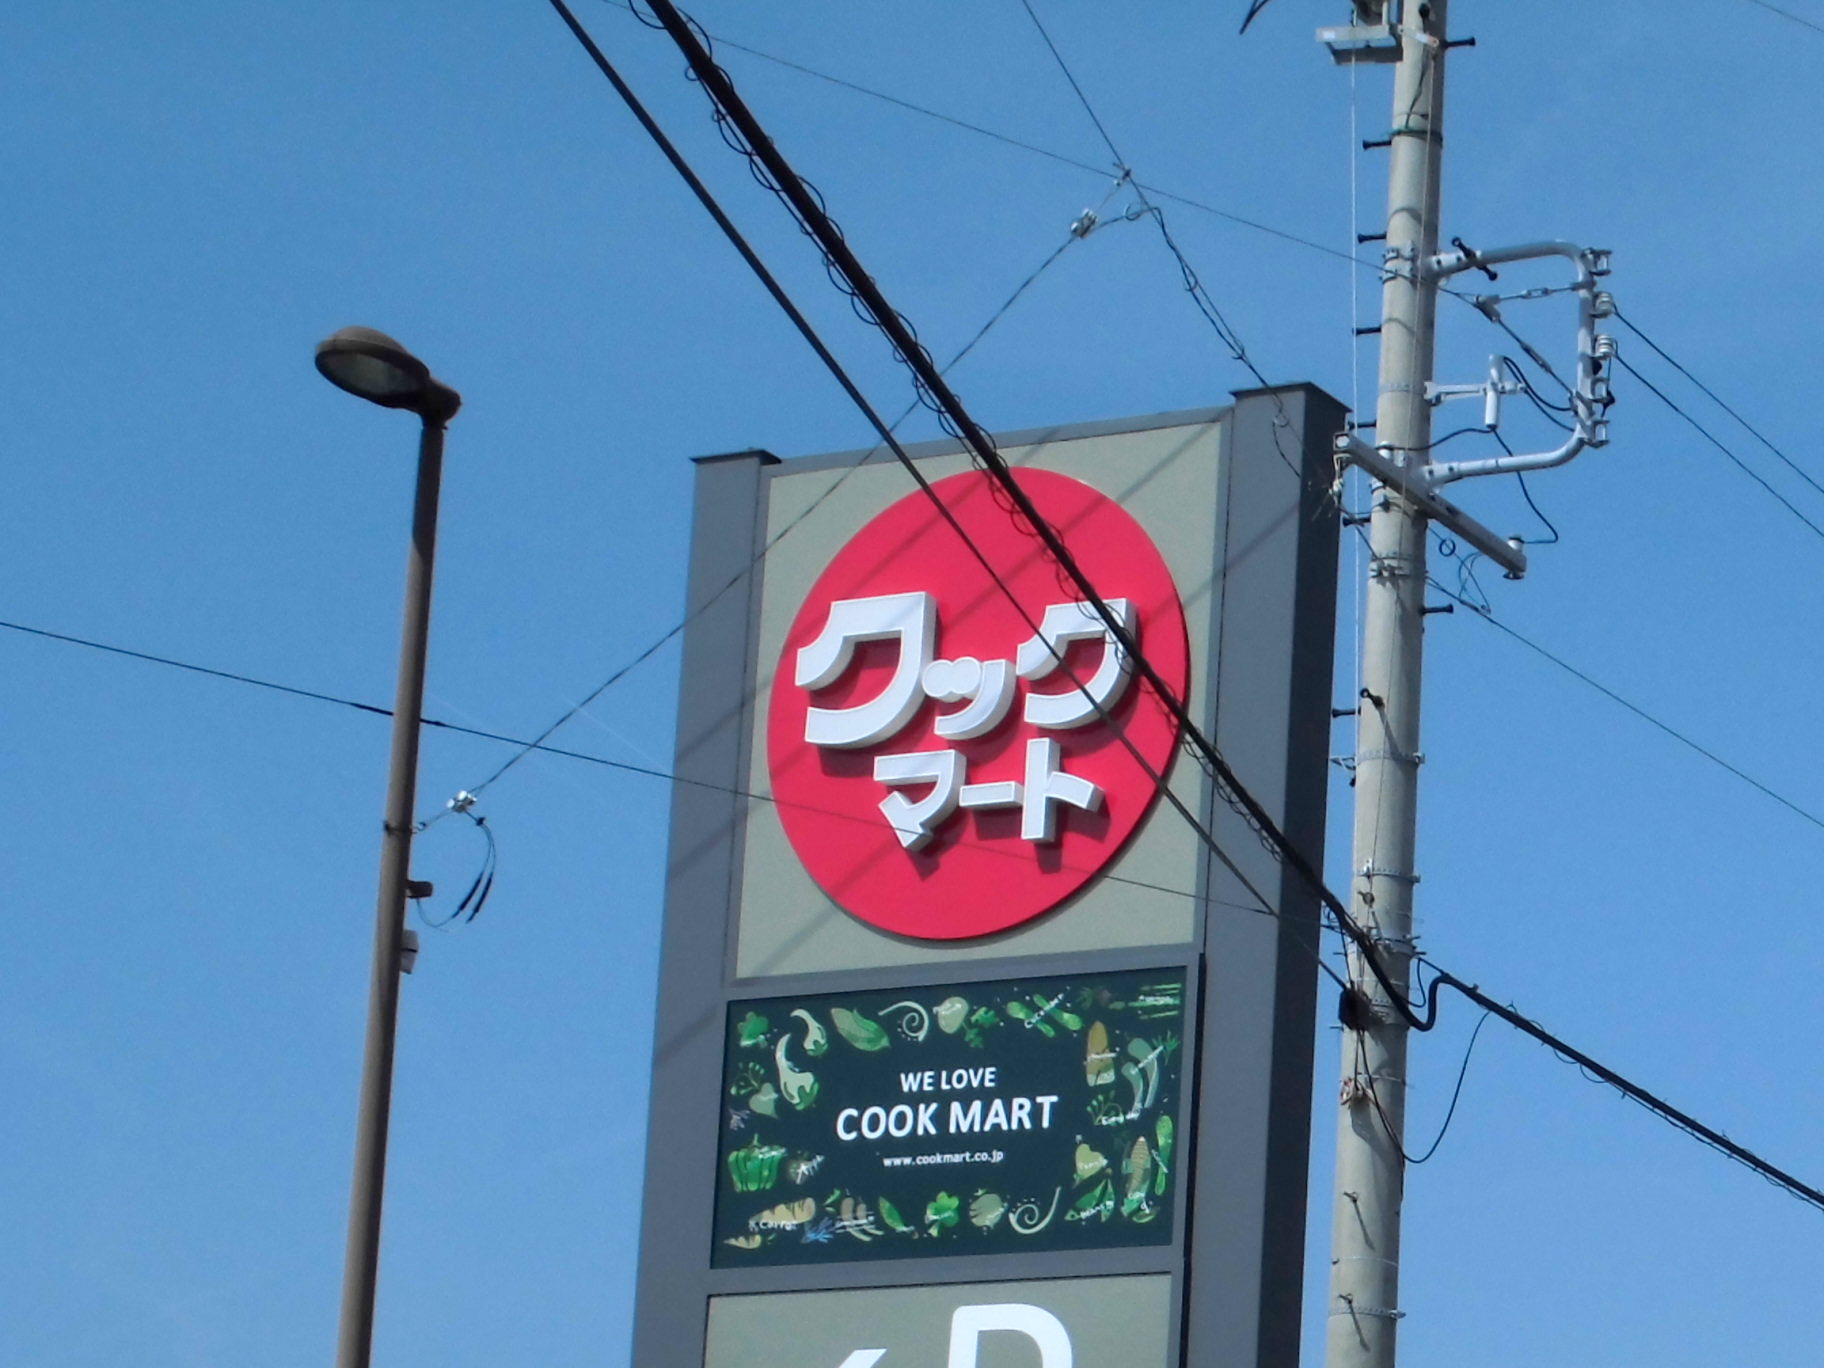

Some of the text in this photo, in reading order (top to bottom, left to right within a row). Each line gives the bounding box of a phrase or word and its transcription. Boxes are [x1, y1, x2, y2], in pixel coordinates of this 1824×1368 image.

[795, 592, 1137, 748] クック
[873, 737, 1104, 851] マート
[901, 1067, 996, 1092] WE LOVE
[836, 1102, 938, 1141] COOK
[949, 1095, 1059, 1134] MART
[883, 1150, 1004, 1167] www.cookmart.co.jp
